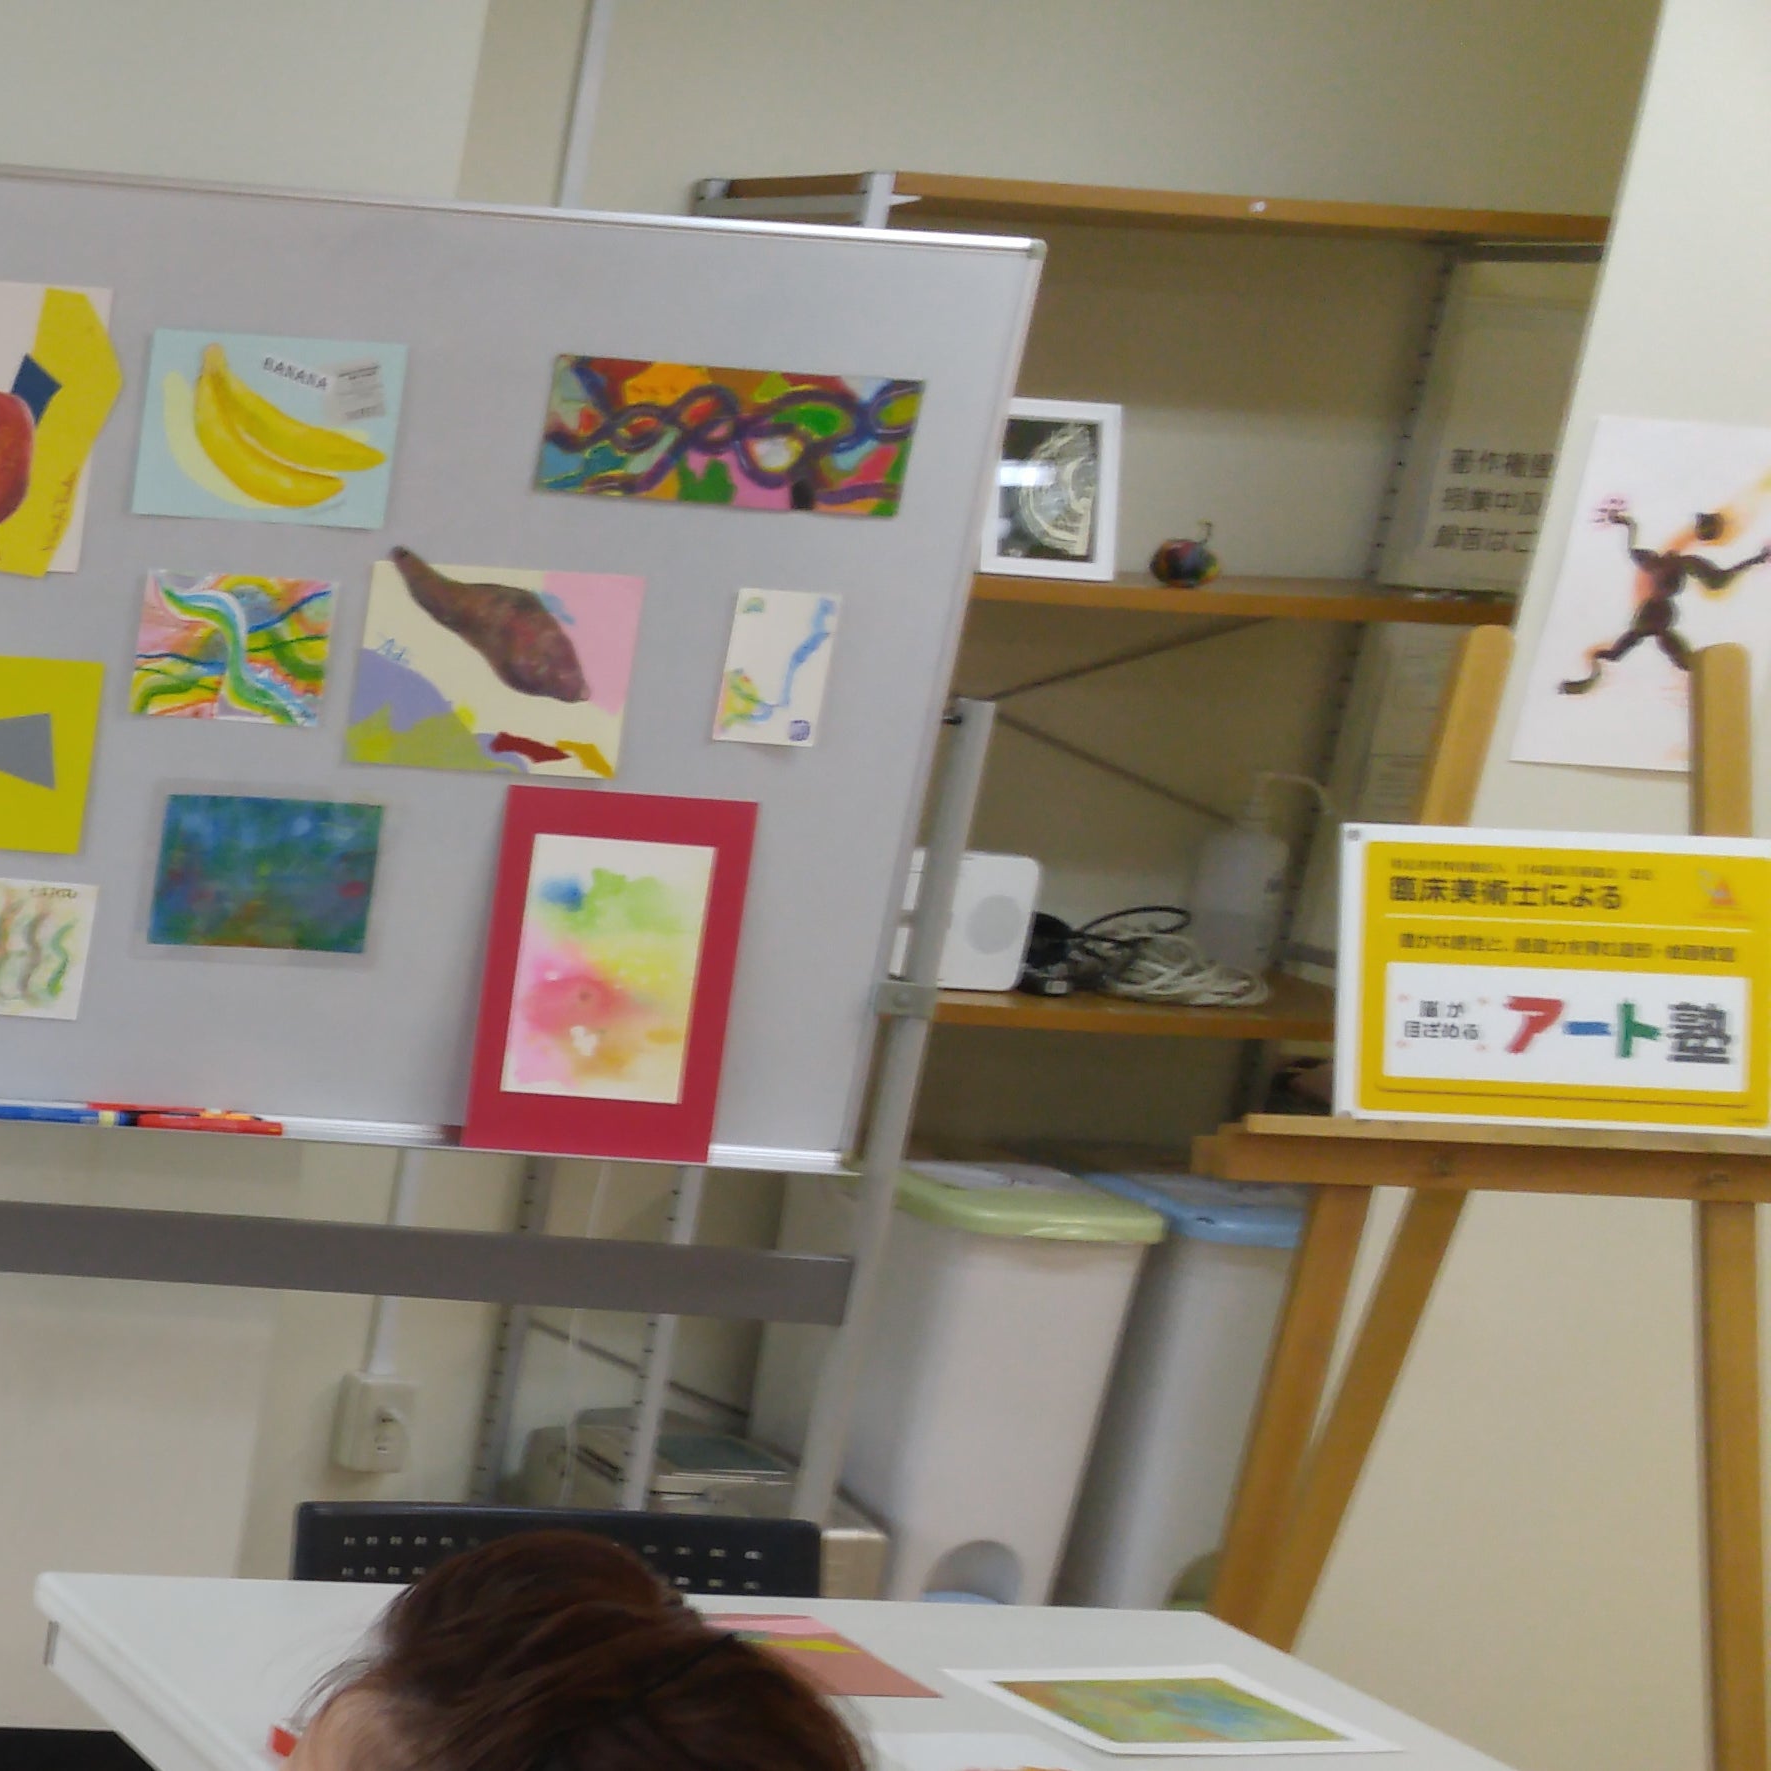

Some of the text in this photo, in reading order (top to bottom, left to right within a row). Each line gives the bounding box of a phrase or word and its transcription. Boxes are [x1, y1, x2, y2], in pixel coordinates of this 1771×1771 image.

[262, 357, 328, 391] BANANA
[1389, 875, 1625, 910] 臨床美術士による
[1404, 1021, 1481, 1041] 目ざめる
[1503, 995, 1732, 1065] アート塾
